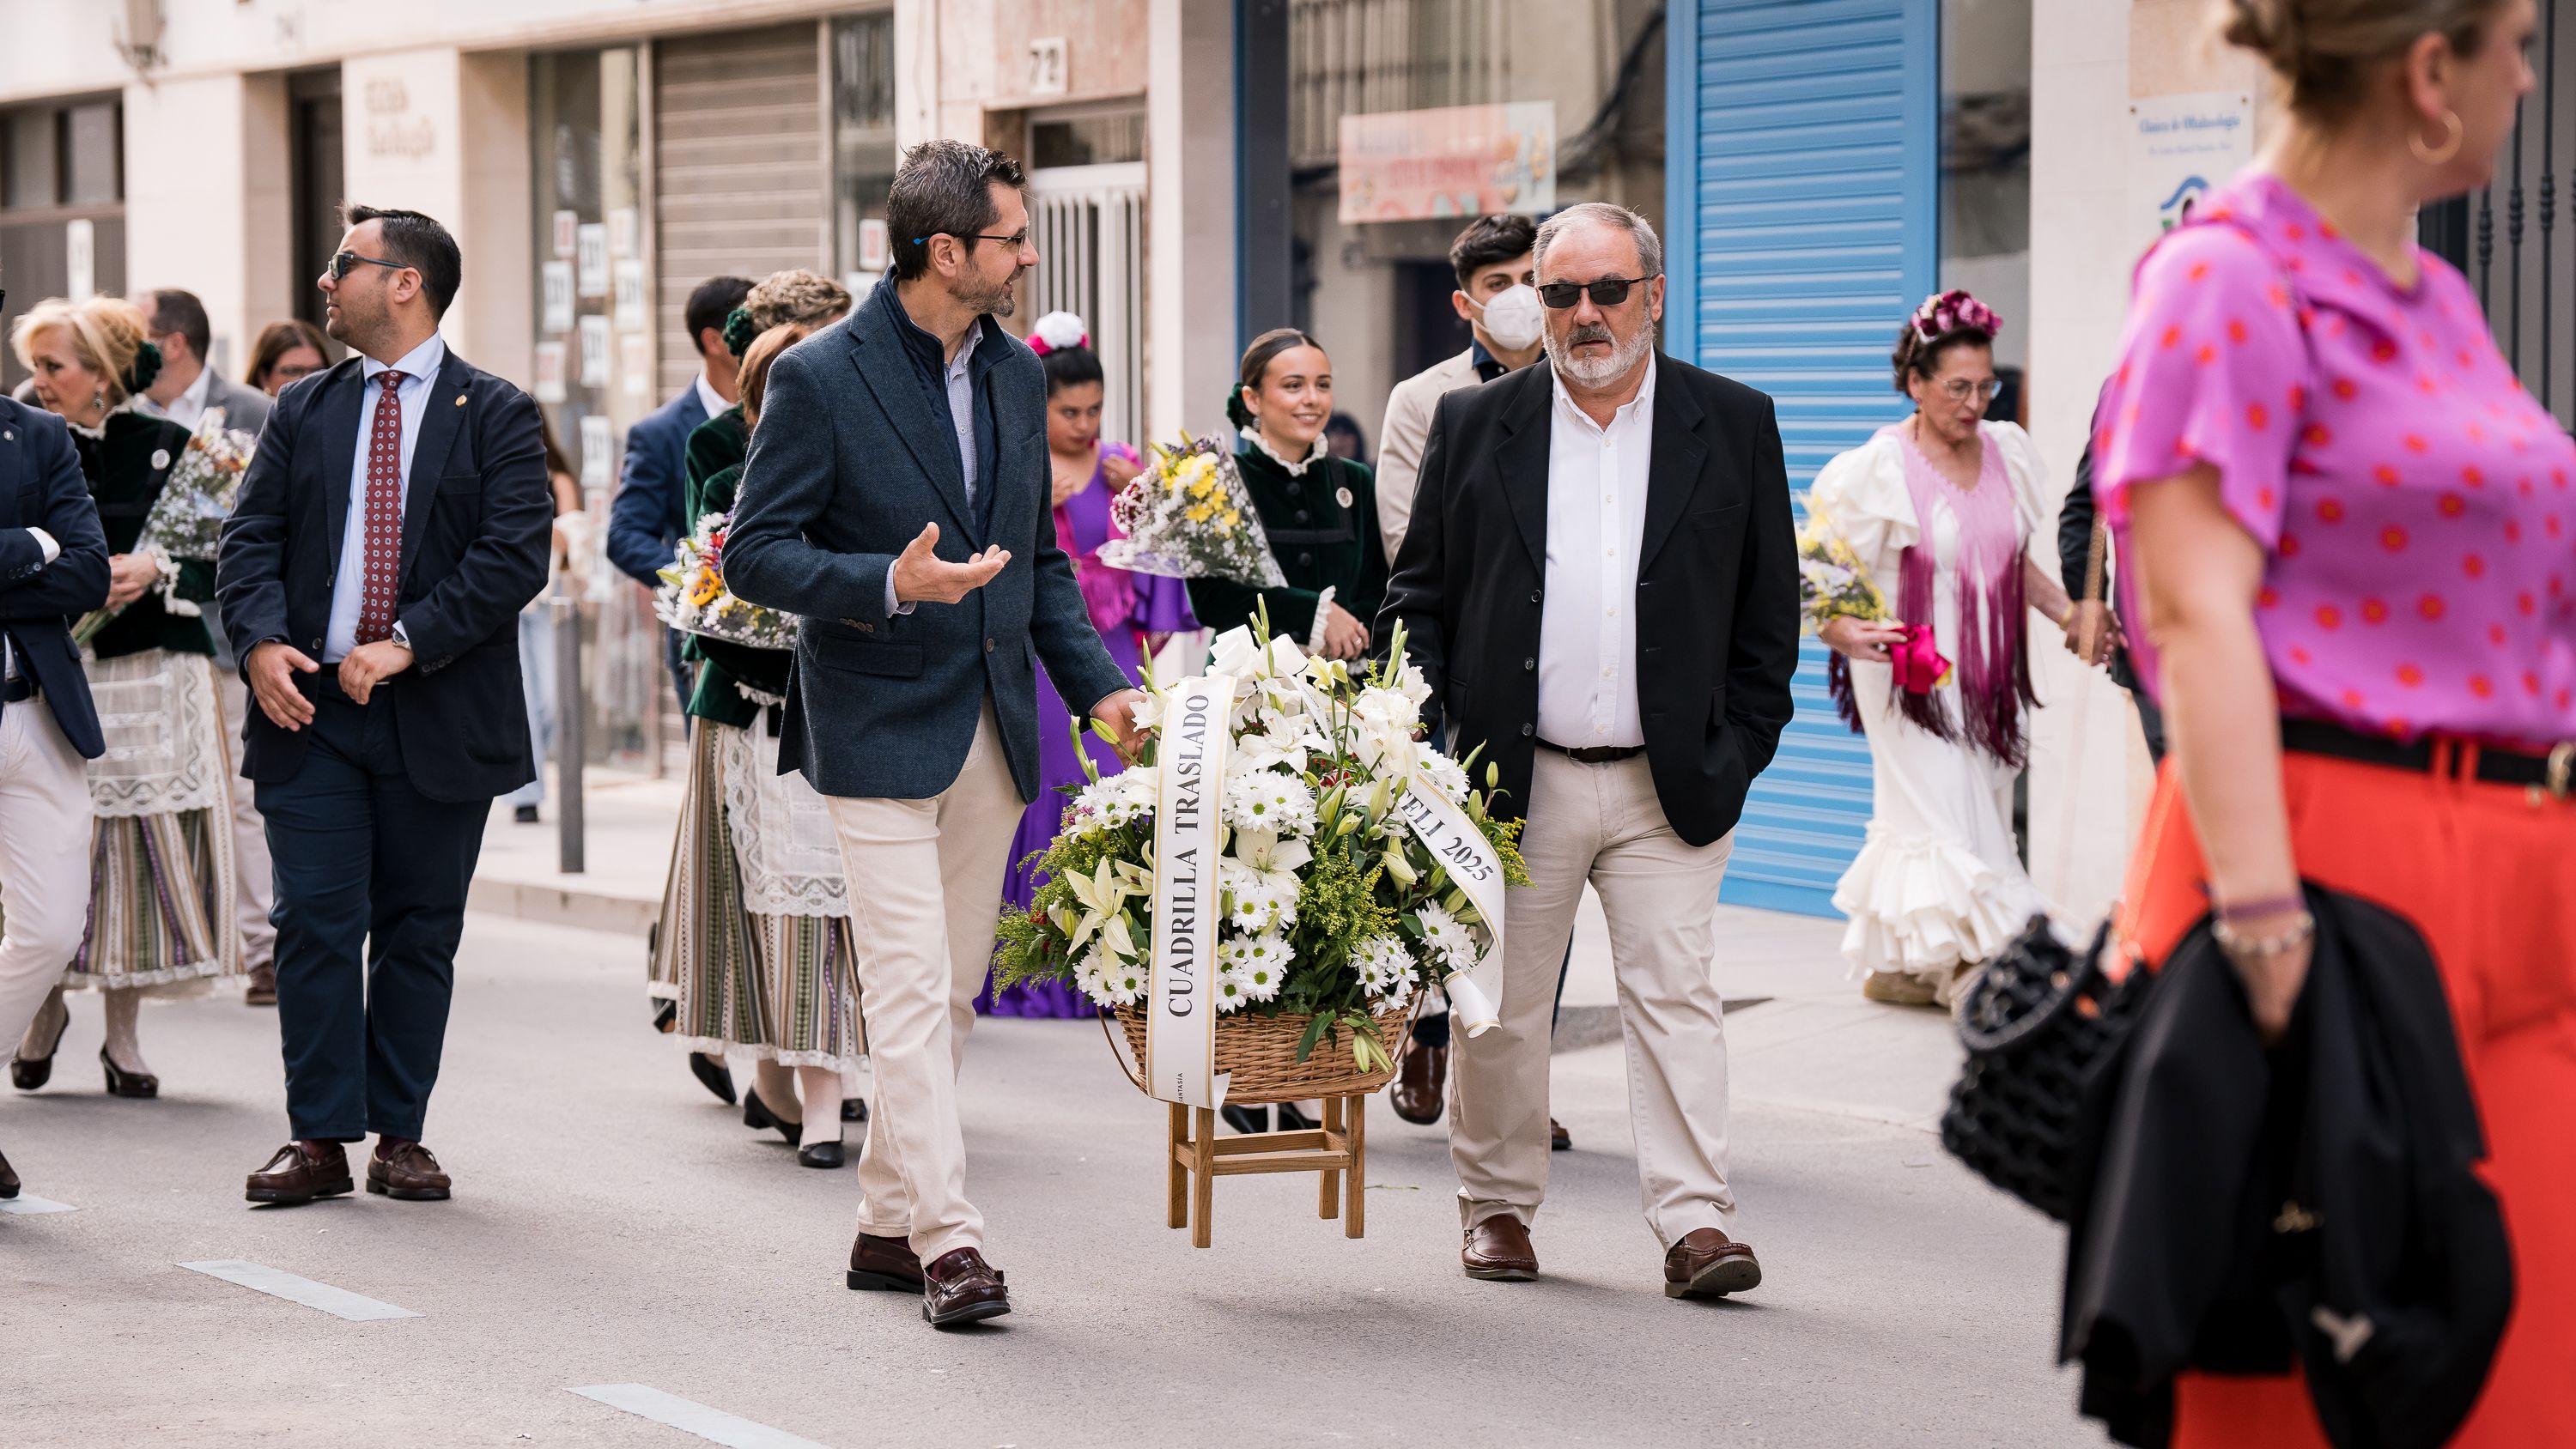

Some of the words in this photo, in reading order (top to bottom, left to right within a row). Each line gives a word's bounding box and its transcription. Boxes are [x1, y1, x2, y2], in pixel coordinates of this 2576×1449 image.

[1030, 47, 1060, 84] 72
[1176, 694, 1209, 834] TRASLADO
[1401, 785, 1445, 838] ELI
[1441, 836, 1494, 881] 2025
[1168, 846, 1198, 1017] CUADRILLA
